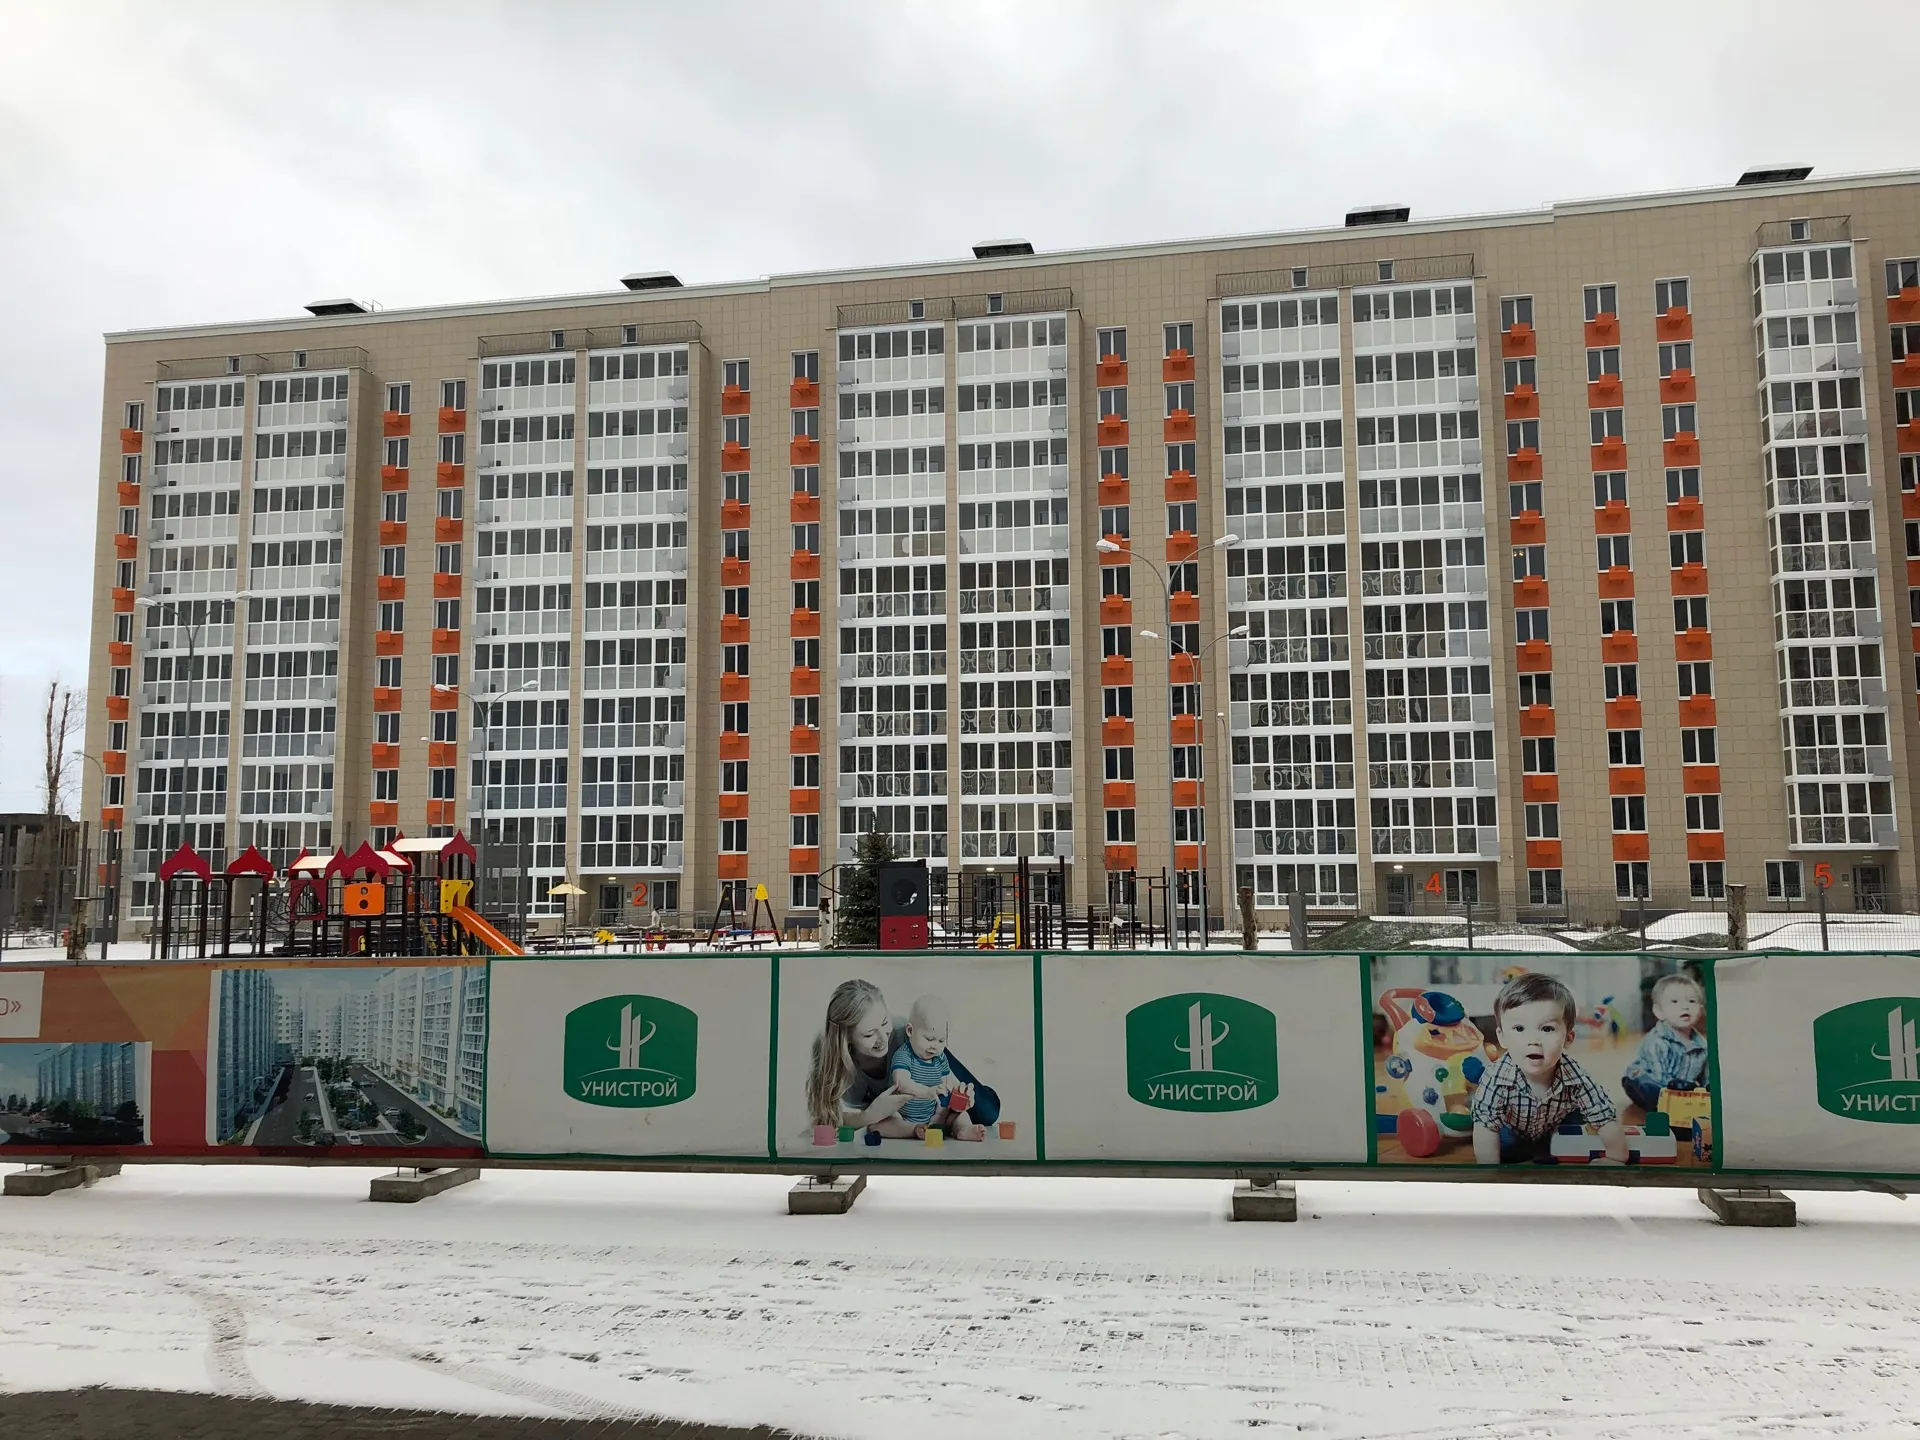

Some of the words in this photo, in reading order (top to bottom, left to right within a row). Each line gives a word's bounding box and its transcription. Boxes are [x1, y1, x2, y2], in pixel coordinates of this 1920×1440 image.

[1425, 871, 1443, 897] 4
[1814, 863, 1834, 888] 5
[632, 882, 648, 906] 2
[580, 1078, 678, 1097] УНИСТРОЙ
[1147, 1080, 1258, 1101] УНИСТРОЙ
[1840, 1093, 1920, 1112] УНИСТ
